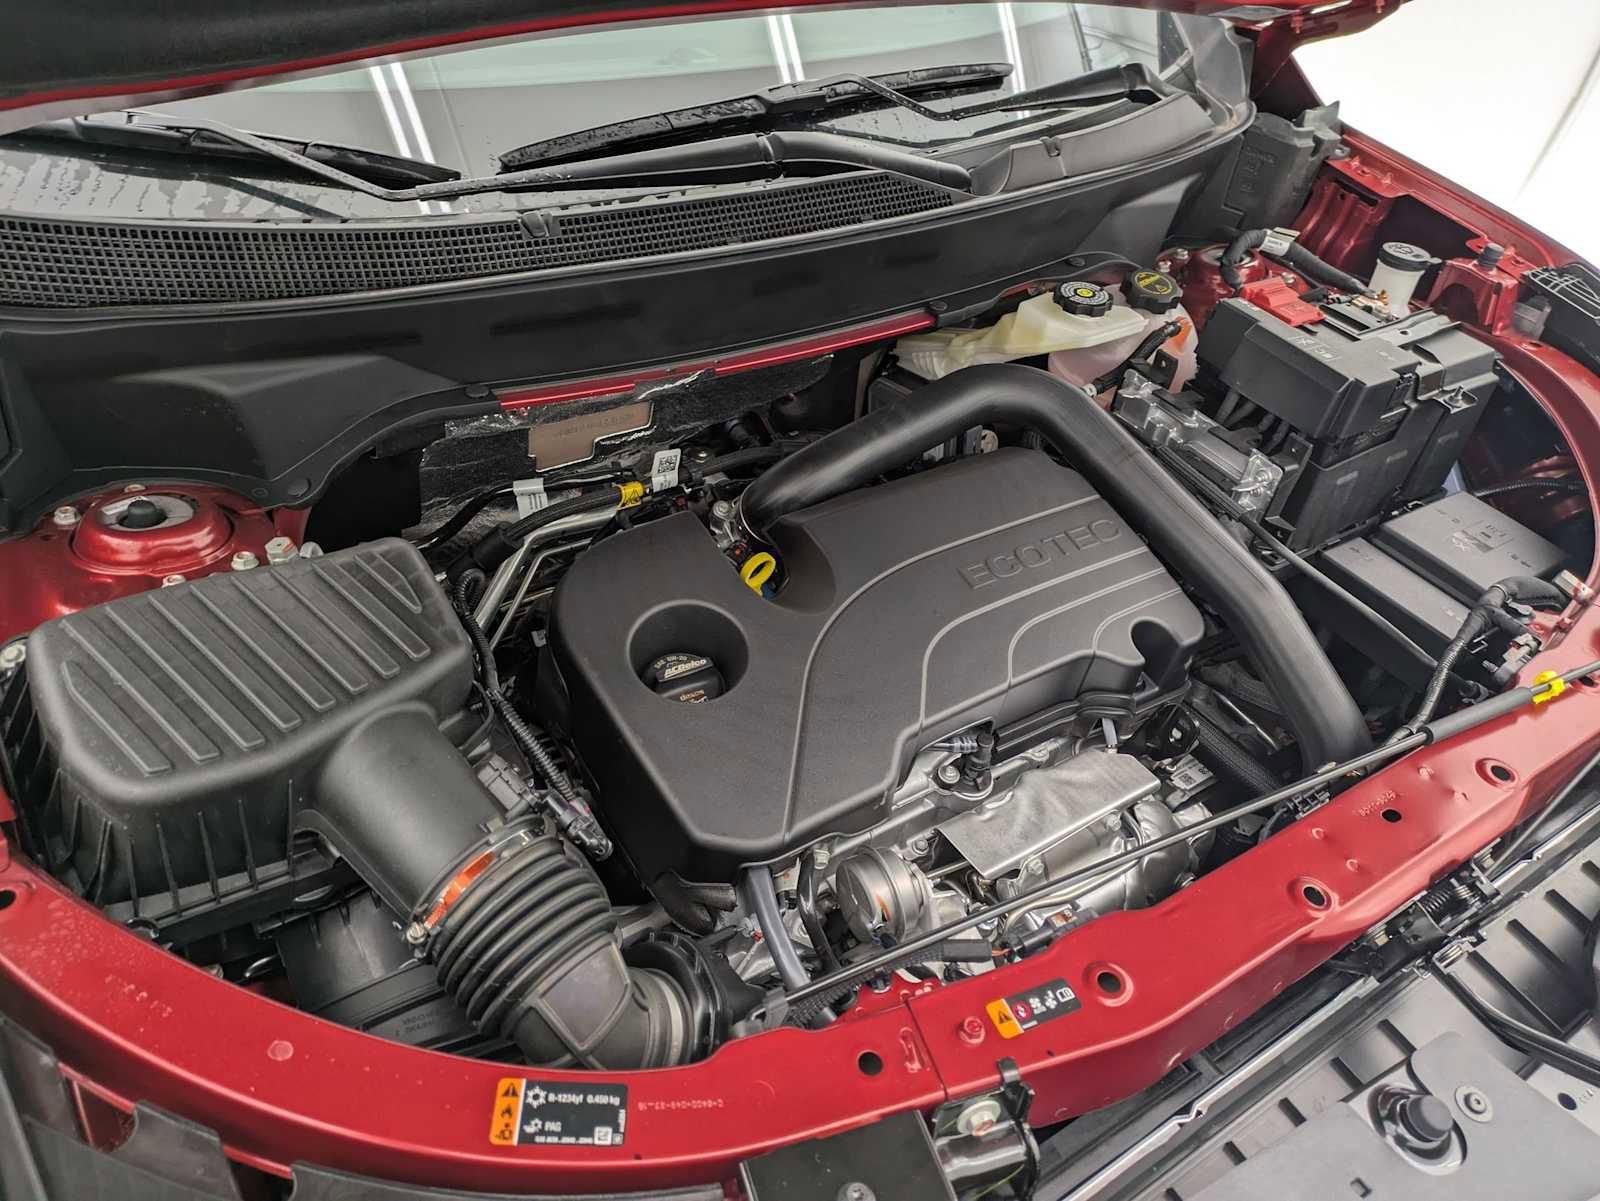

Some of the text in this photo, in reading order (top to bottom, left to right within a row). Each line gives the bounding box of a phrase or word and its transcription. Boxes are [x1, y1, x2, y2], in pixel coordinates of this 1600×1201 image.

[956, 518, 1122, 590] ECOTEC
[664, 658, 707, 679] ACDelco
[544, 1121, 562, 1132] PAG
